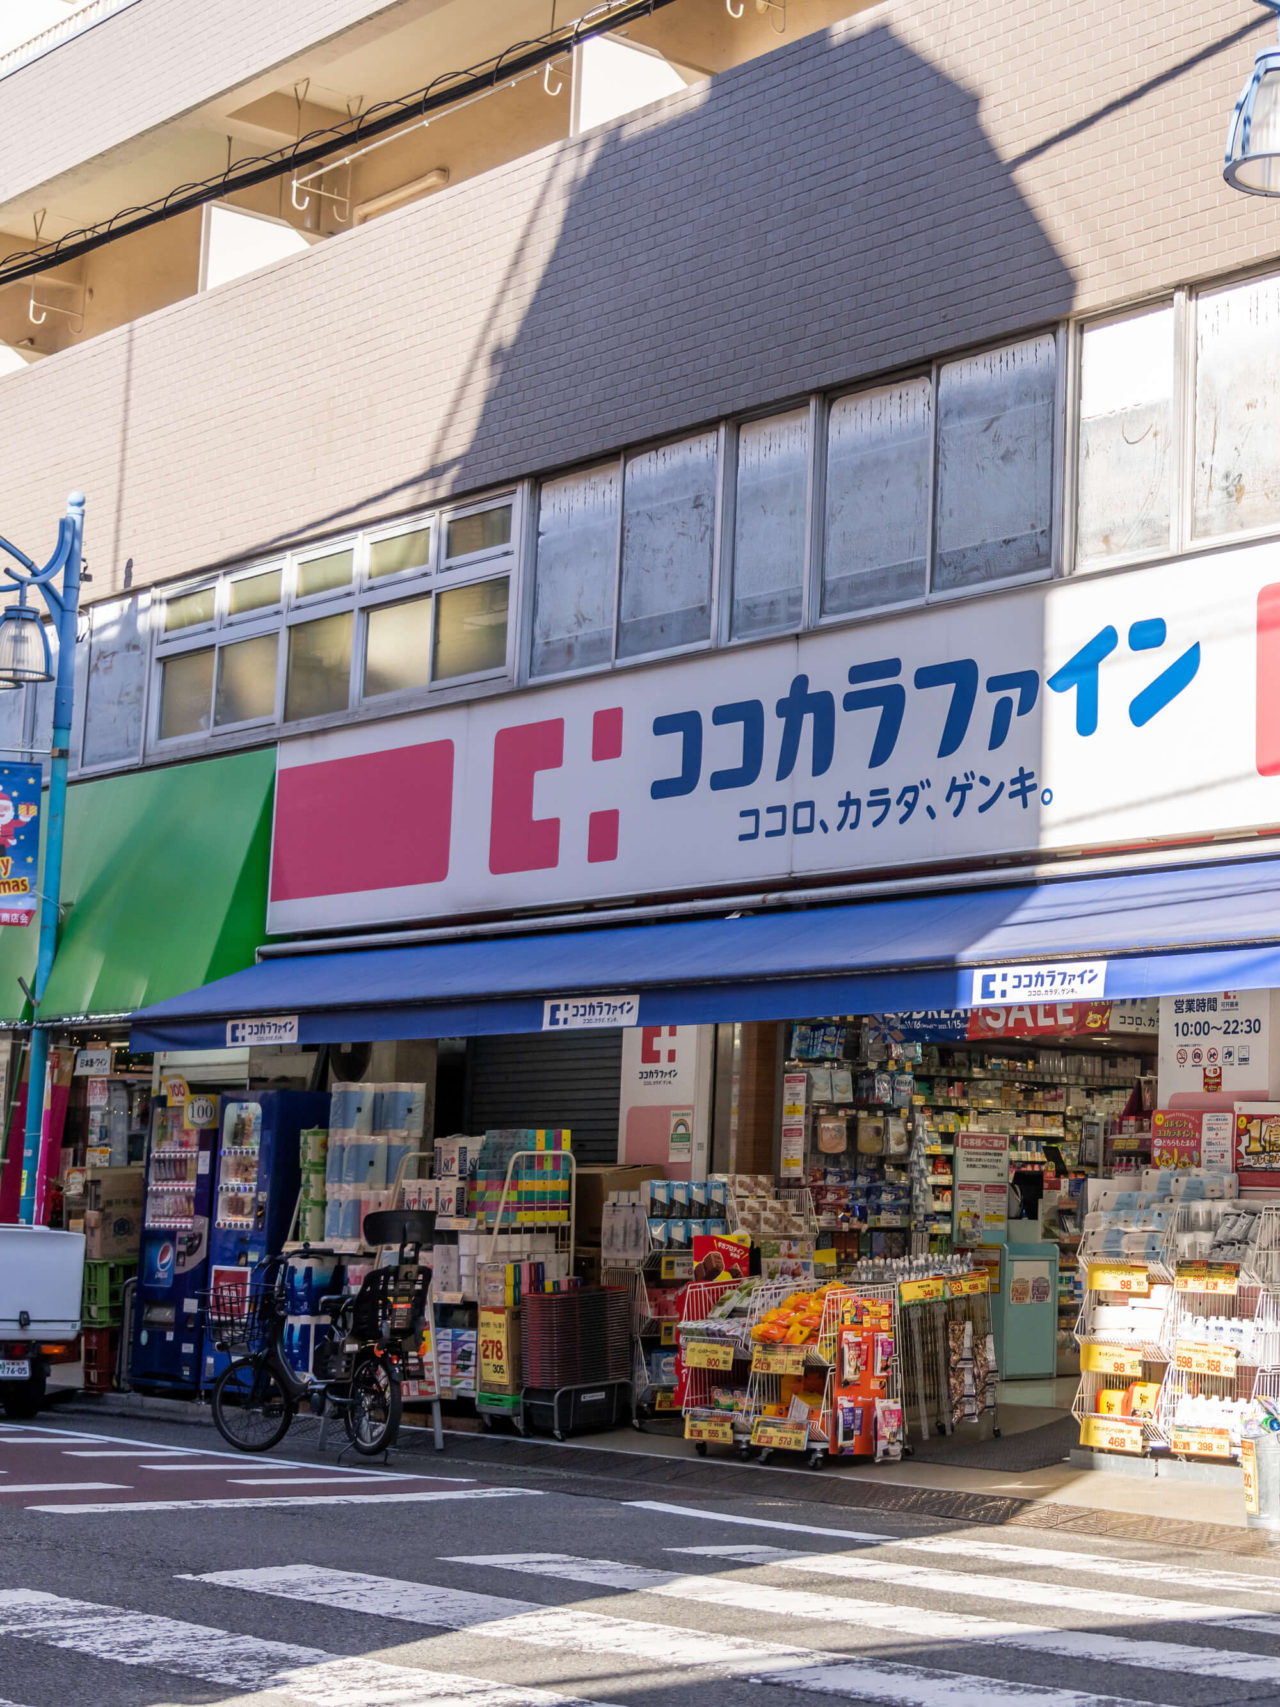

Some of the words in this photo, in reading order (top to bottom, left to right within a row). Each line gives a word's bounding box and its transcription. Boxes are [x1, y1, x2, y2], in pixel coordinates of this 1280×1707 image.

[650, 617, 1201, 800] ココカラファイン
[738, 766, 1053, 842] ココロ、カラダ、ゲンキ。
[1012, 969, 1099, 989] ココカラファイン
[572, 1001, 634, 1018] ココカラファイン
[1174, 998, 1218, 1014] 営業時間
[985, 1001, 1074, 1029] SALE
[247, 1020, 295, 1036] ココカラファイン
[170, 1084, 186, 1097] 100
[190, 1101, 214, 1119] 100
[1120, 1279, 1132, 1290] 98
[481, 1339, 504, 1361] 278
[492, 1364, 505, 1375] 305
[1113, 1361, 1126, 1373] 98
[1176, 1355, 1193, 1369] 598
[1108, 1436, 1126, 1448] 468
[1197, 1441, 1214, 1452] 398
